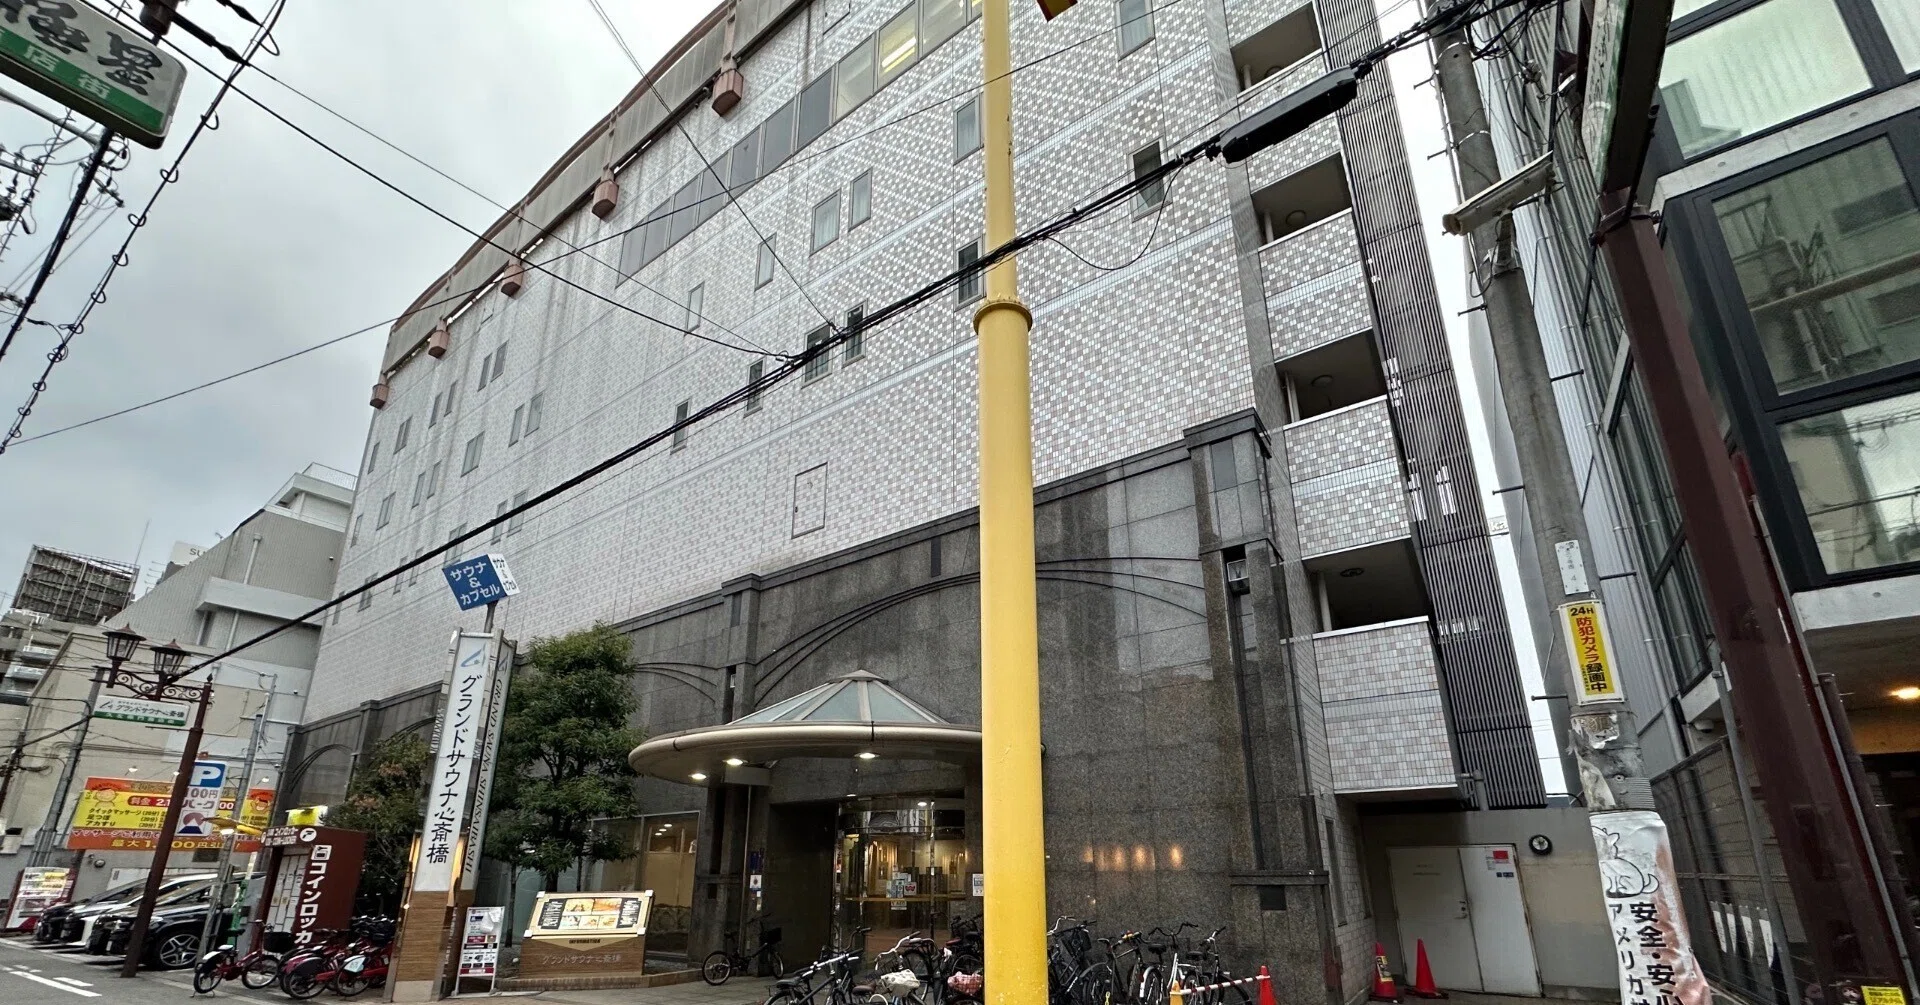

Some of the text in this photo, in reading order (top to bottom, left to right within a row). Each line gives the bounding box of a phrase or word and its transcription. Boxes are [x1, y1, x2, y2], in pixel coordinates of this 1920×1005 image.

[0, 28, 111, 100] 店街
[450, 562, 487, 581] サウナ
[469, 577, 481, 588] &
[460, 584, 500, 605] カプセル
[1570, 606, 1594, 617] 24H
[1576, 616, 1607, 693] 防犯カメラ録画中
[190, 766, 222, 786] P
[427, 674, 483, 864] グランドサウナ心斎橋
[465, 679, 503, 874] GRAND SAUNA SHINSAIBASHI
[89, 808, 142, 816] クイックマッサージ
[131, 797, 151, 806] 料金
[294, 862, 327, 949] コインロッカ
[1608, 903, 1650, 1005] アメリカ
